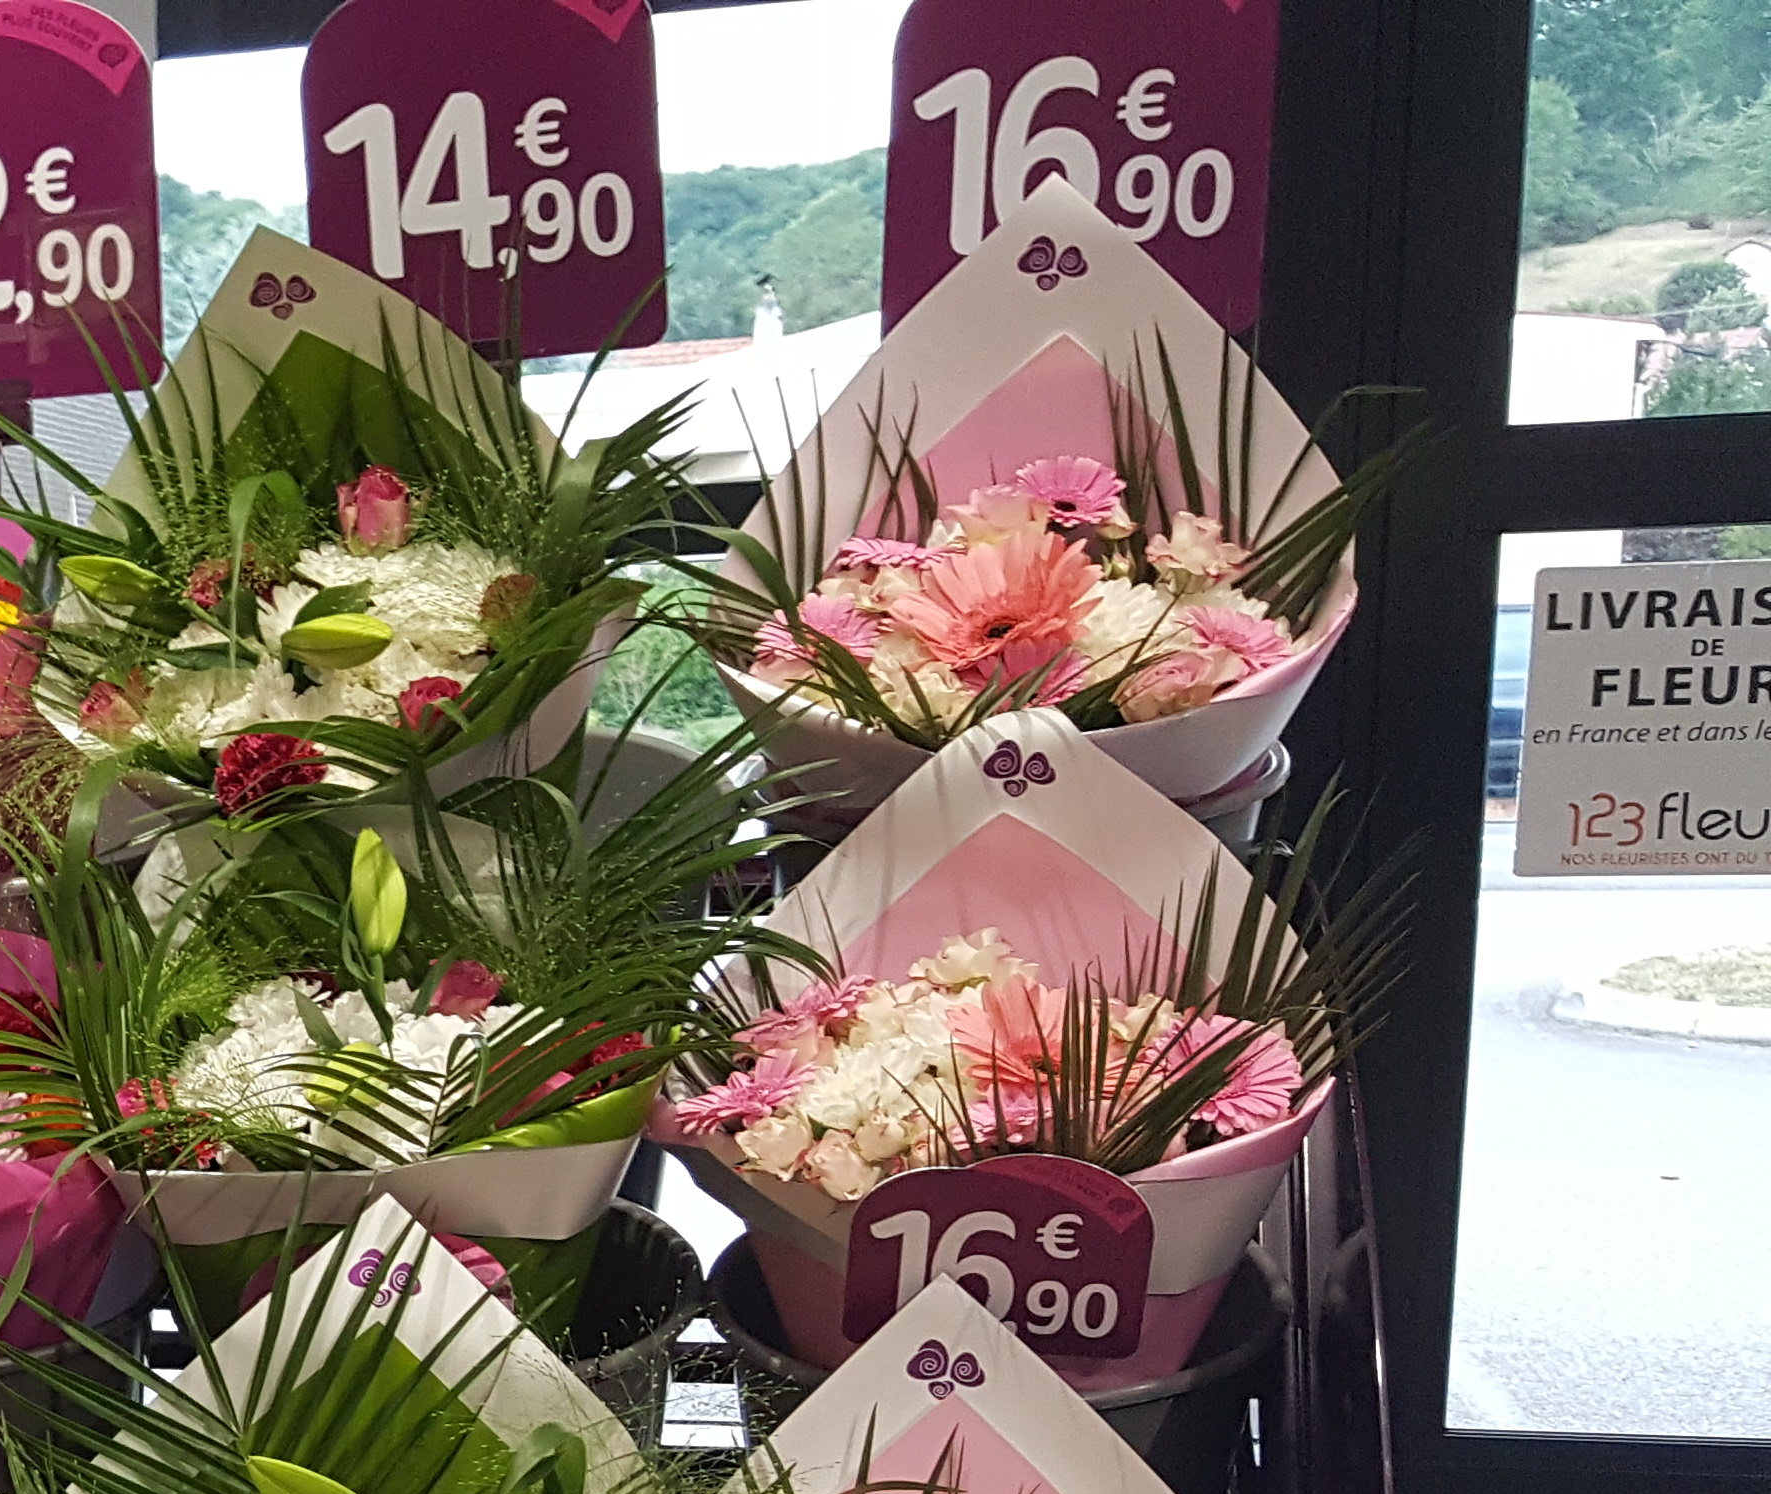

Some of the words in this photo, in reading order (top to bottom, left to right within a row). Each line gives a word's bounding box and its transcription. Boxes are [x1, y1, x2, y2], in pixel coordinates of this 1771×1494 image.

[912, 54, 1234, 257] 1690
[1690, 638, 1725, 657] DE
[1591, 664, 1771, 707] FLEUR
[1533, 727, 1560, 745] en
[1567, 722, 1651, 744] France
[1657, 724, 1680, 742] et
[1687, 721, 1748, 742] dans
[1560, 852, 1595, 866] NOS
[1601, 851, 1688, 865] FLEURISTES
[1695, 851, 1729, 865] ONT
